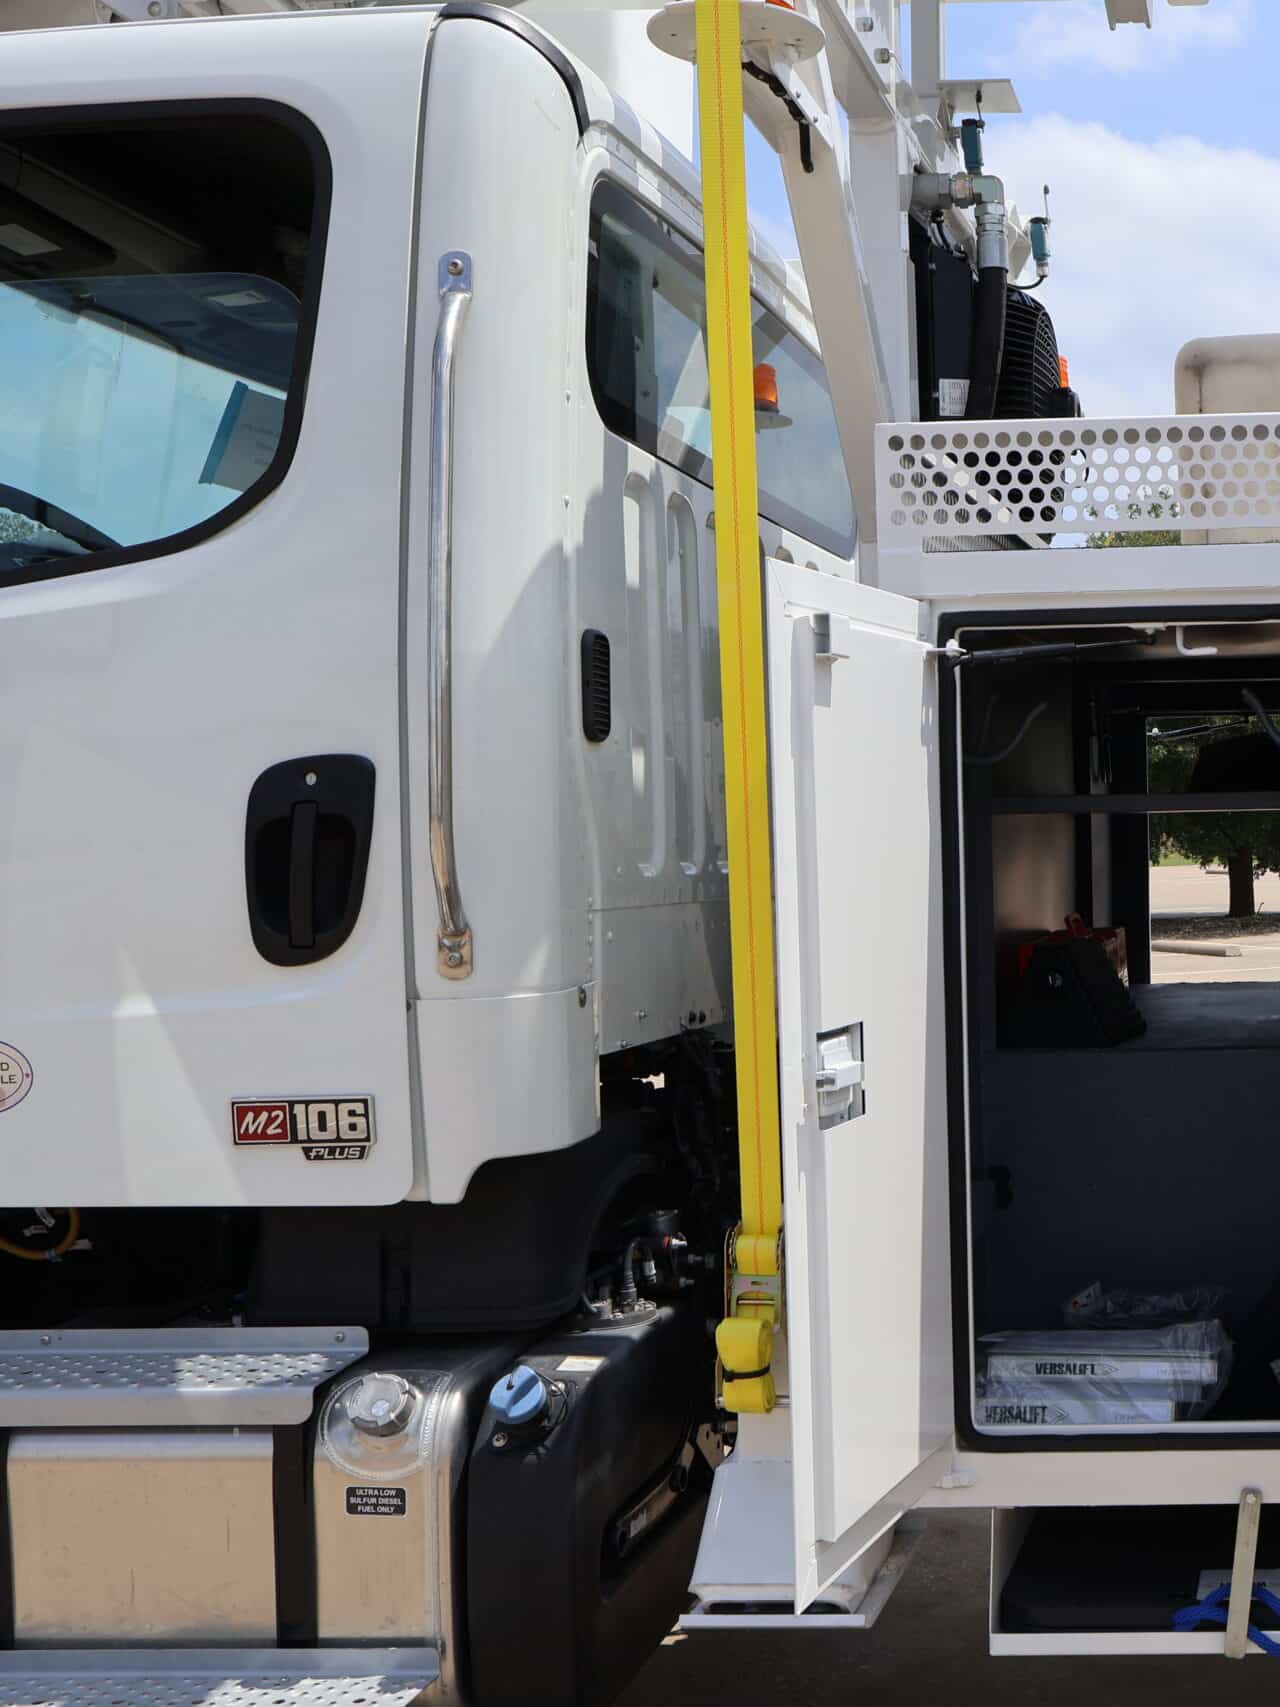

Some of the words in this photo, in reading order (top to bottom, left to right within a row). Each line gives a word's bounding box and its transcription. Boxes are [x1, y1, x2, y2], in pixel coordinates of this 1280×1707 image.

[0, 1074, 17, 1084] LE
[240, 1110, 284, 1135] M2
[293, 1103, 368, 1140] 106
[309, 1147, 361, 1160] PLUS
[1035, 1362, 1097, 1376] VERSALIFT
[984, 1405, 1048, 1424] VERSALIFT
[356, 1488, 379, 1496] ULTRA
[350, 1496, 377, 1505] SULFUR
[378, 1497, 403, 1505] DIESEL
[357, 1505, 376, 1513] FUEL
[376, 1505, 395, 1513] ONLY
